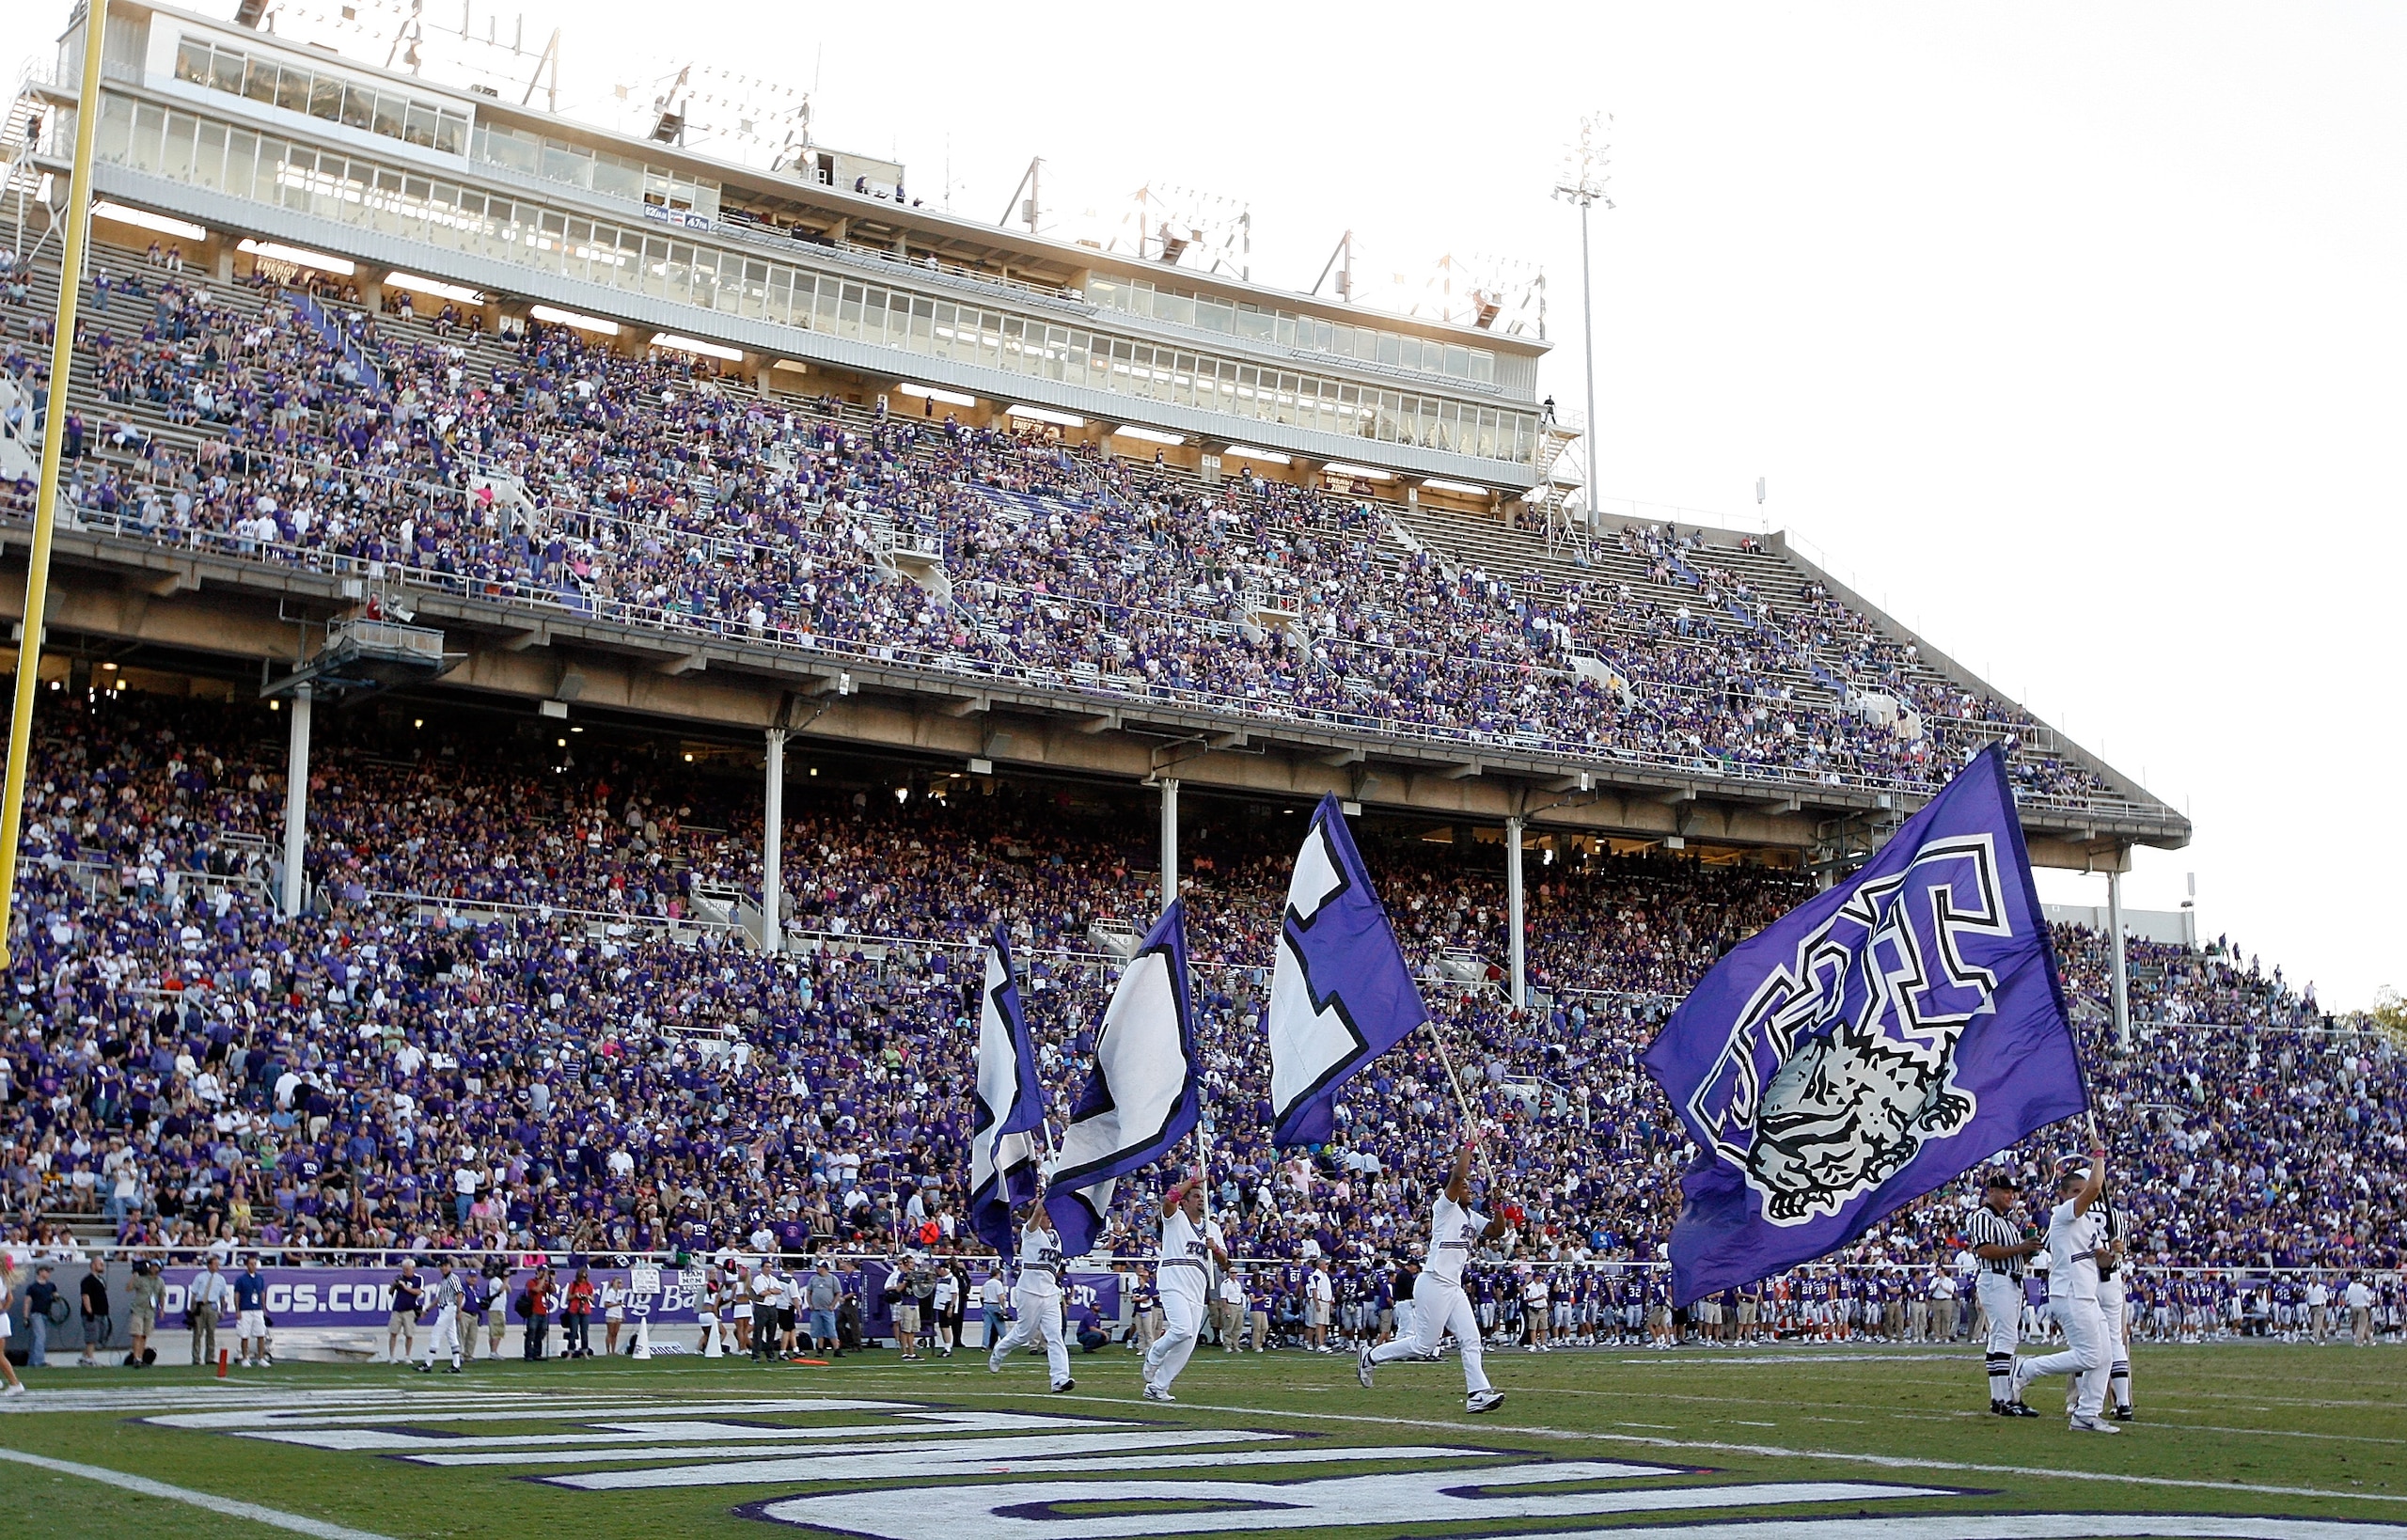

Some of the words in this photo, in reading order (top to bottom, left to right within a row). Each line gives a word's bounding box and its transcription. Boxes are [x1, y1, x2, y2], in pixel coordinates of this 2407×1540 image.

[1330, 483, 1350, 493] ZONE
[748, 1210, 761, 1221] 14
[694, 1223, 707, 1234] TCU
[1484, 1281, 1489, 1293] 1
[1628, 1287, 1641, 1297] 32
[2275, 1288, 2290, 1299] 22
